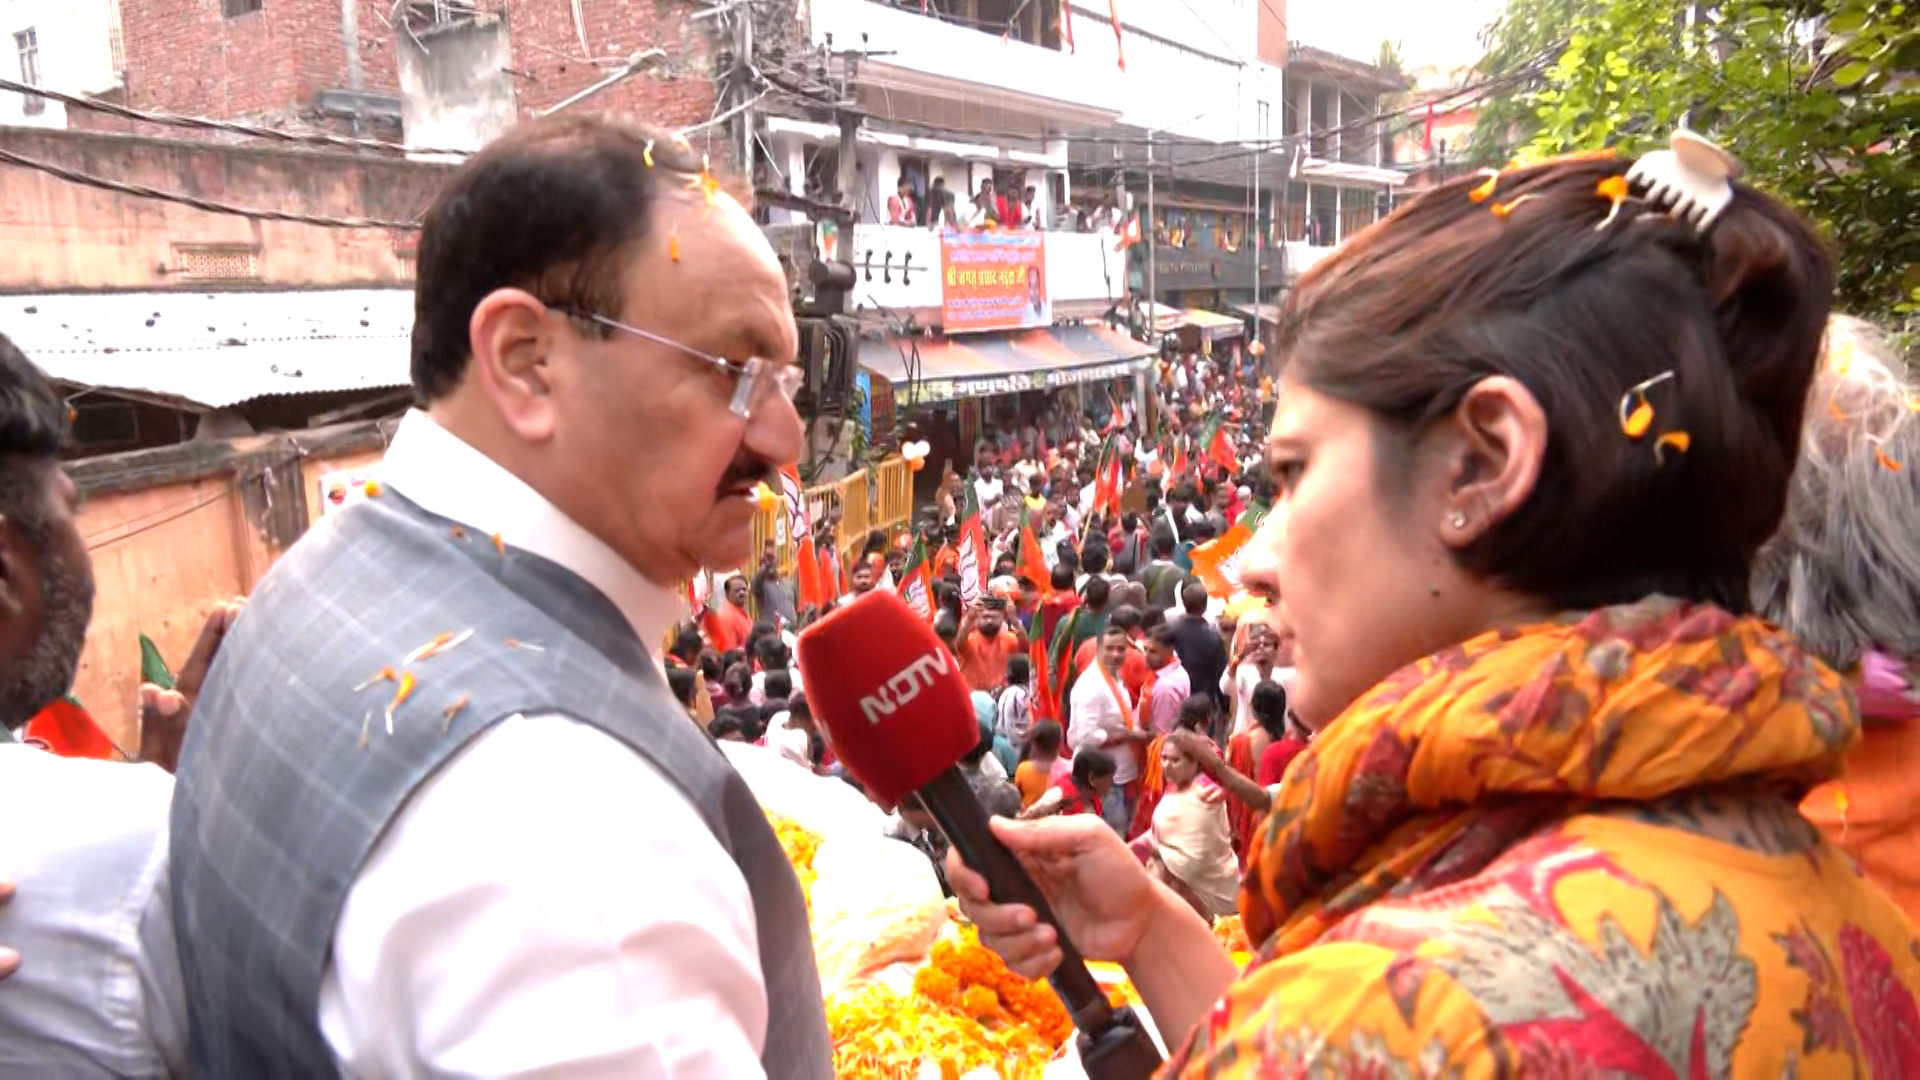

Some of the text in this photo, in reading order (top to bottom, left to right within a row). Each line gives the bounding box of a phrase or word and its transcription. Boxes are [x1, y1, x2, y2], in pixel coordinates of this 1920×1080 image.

[946, 265, 956, 287] श्री
[977, 269, 997, 287] प्रसाद
[1016, 265, 1026, 285] जी
[859, 647, 949, 725] NDTV
